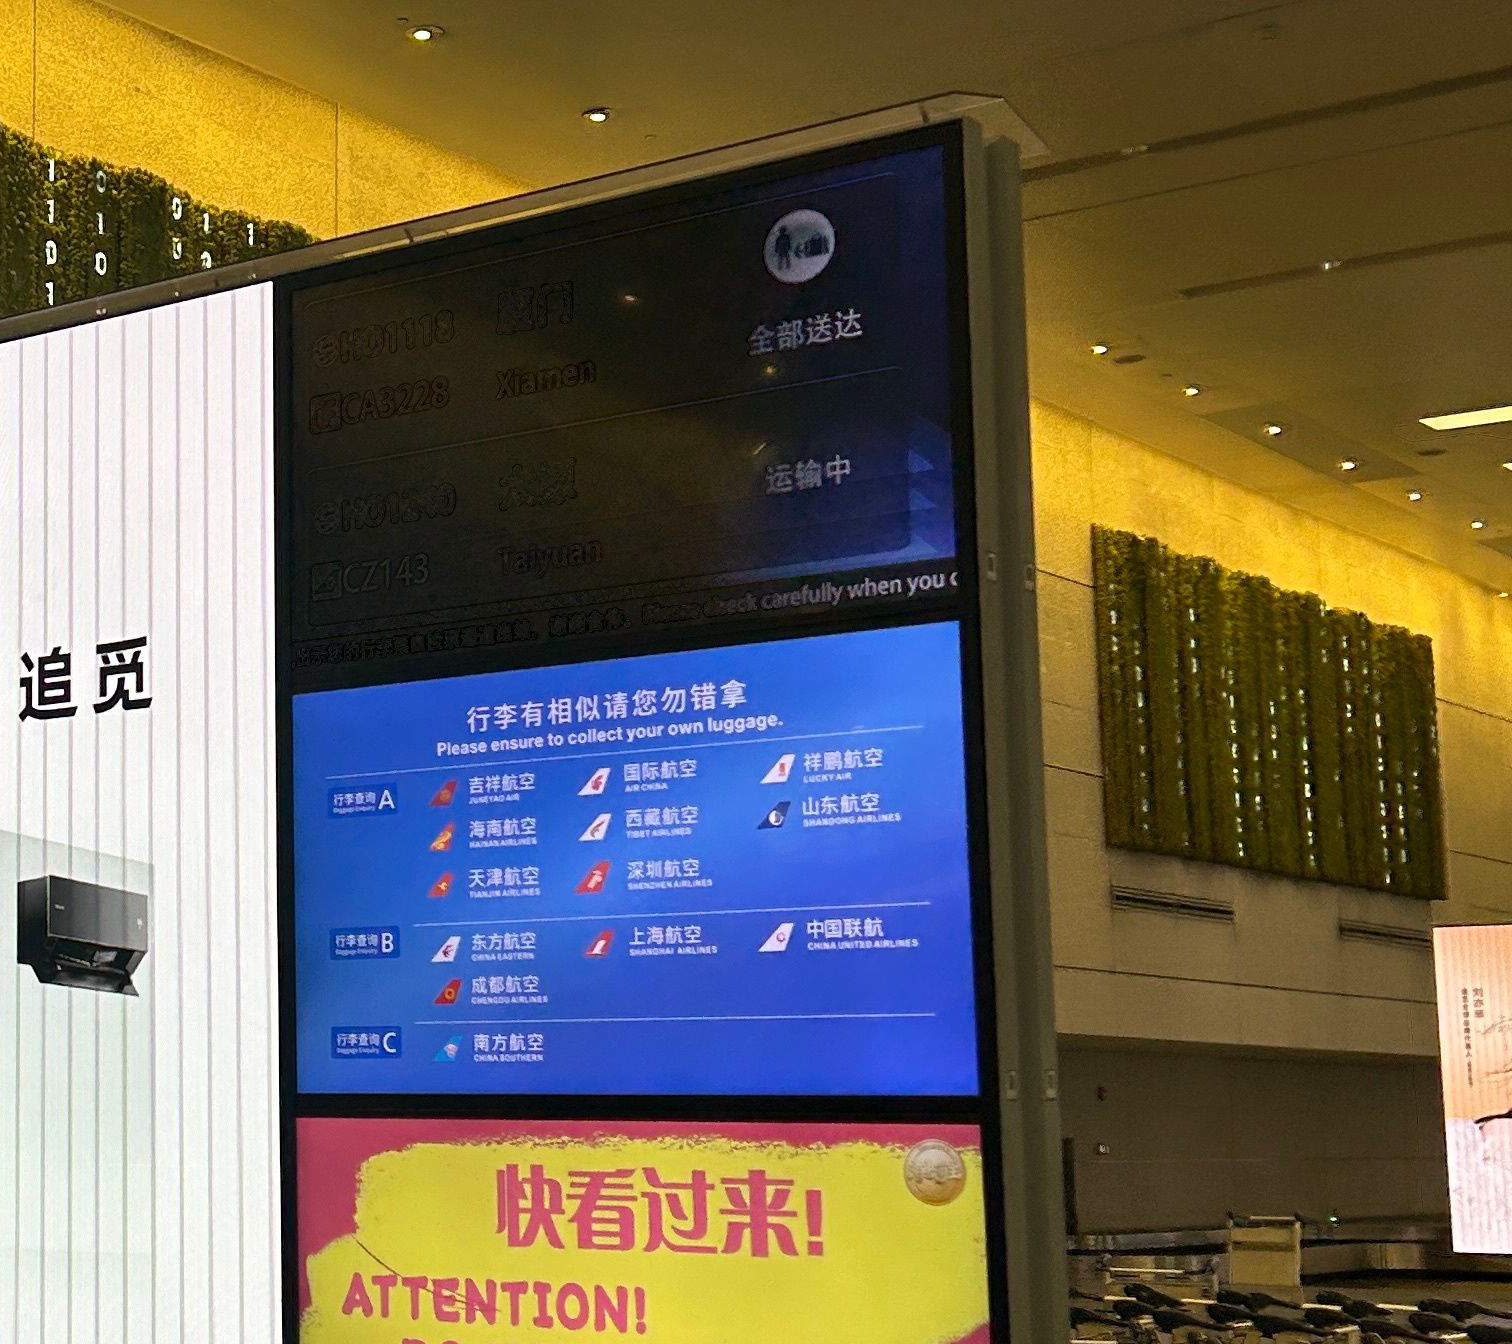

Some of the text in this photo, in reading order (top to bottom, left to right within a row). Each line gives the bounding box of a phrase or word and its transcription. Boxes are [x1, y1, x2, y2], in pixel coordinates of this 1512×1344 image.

[747, 308, 863, 356] 全部送达
[496, 360, 597, 399] Xiamen
[765, 454, 851, 496] 运输中
[497, 540, 603, 579] Taiyuan
[761, 581, 843, 611] carefully
[846, 576, 903, 600] when
[905, 571, 946, 598] you
[19, 635, 153, 723] 追觅
[465, 678, 748, 735] 行李有相似请您勿错拿
[436, 713, 784, 757] Please ensure to collect your own luggage.
[623, 758, 698, 783] 国际航空
[802, 747, 884, 773] 祥鹏航空
[468, 772, 536, 795] 吉祥航空
[377, 789, 396, 810] A
[802, 792, 881, 817] 山东航空
[468, 816, 537, 839] 海南航空
[624, 805, 699, 828] 西藏航空
[468, 866, 540, 889] 天津航空
[626, 858, 700, 881] 深圳航空
[628, 924, 703, 946] 上海航空
[806, 916, 885, 939] 中国联航
[380, 932, 395, 954] B
[471, 931, 537, 952] 东方航空
[471, 974, 540, 995] 成都航空
[382, 1031, 397, 1053] C
[473, 1032, 544, 1053] 南方航空
[495, 1162, 824, 1258] 快看过来!
[341, 1271, 648, 1334] ATTENTION!
